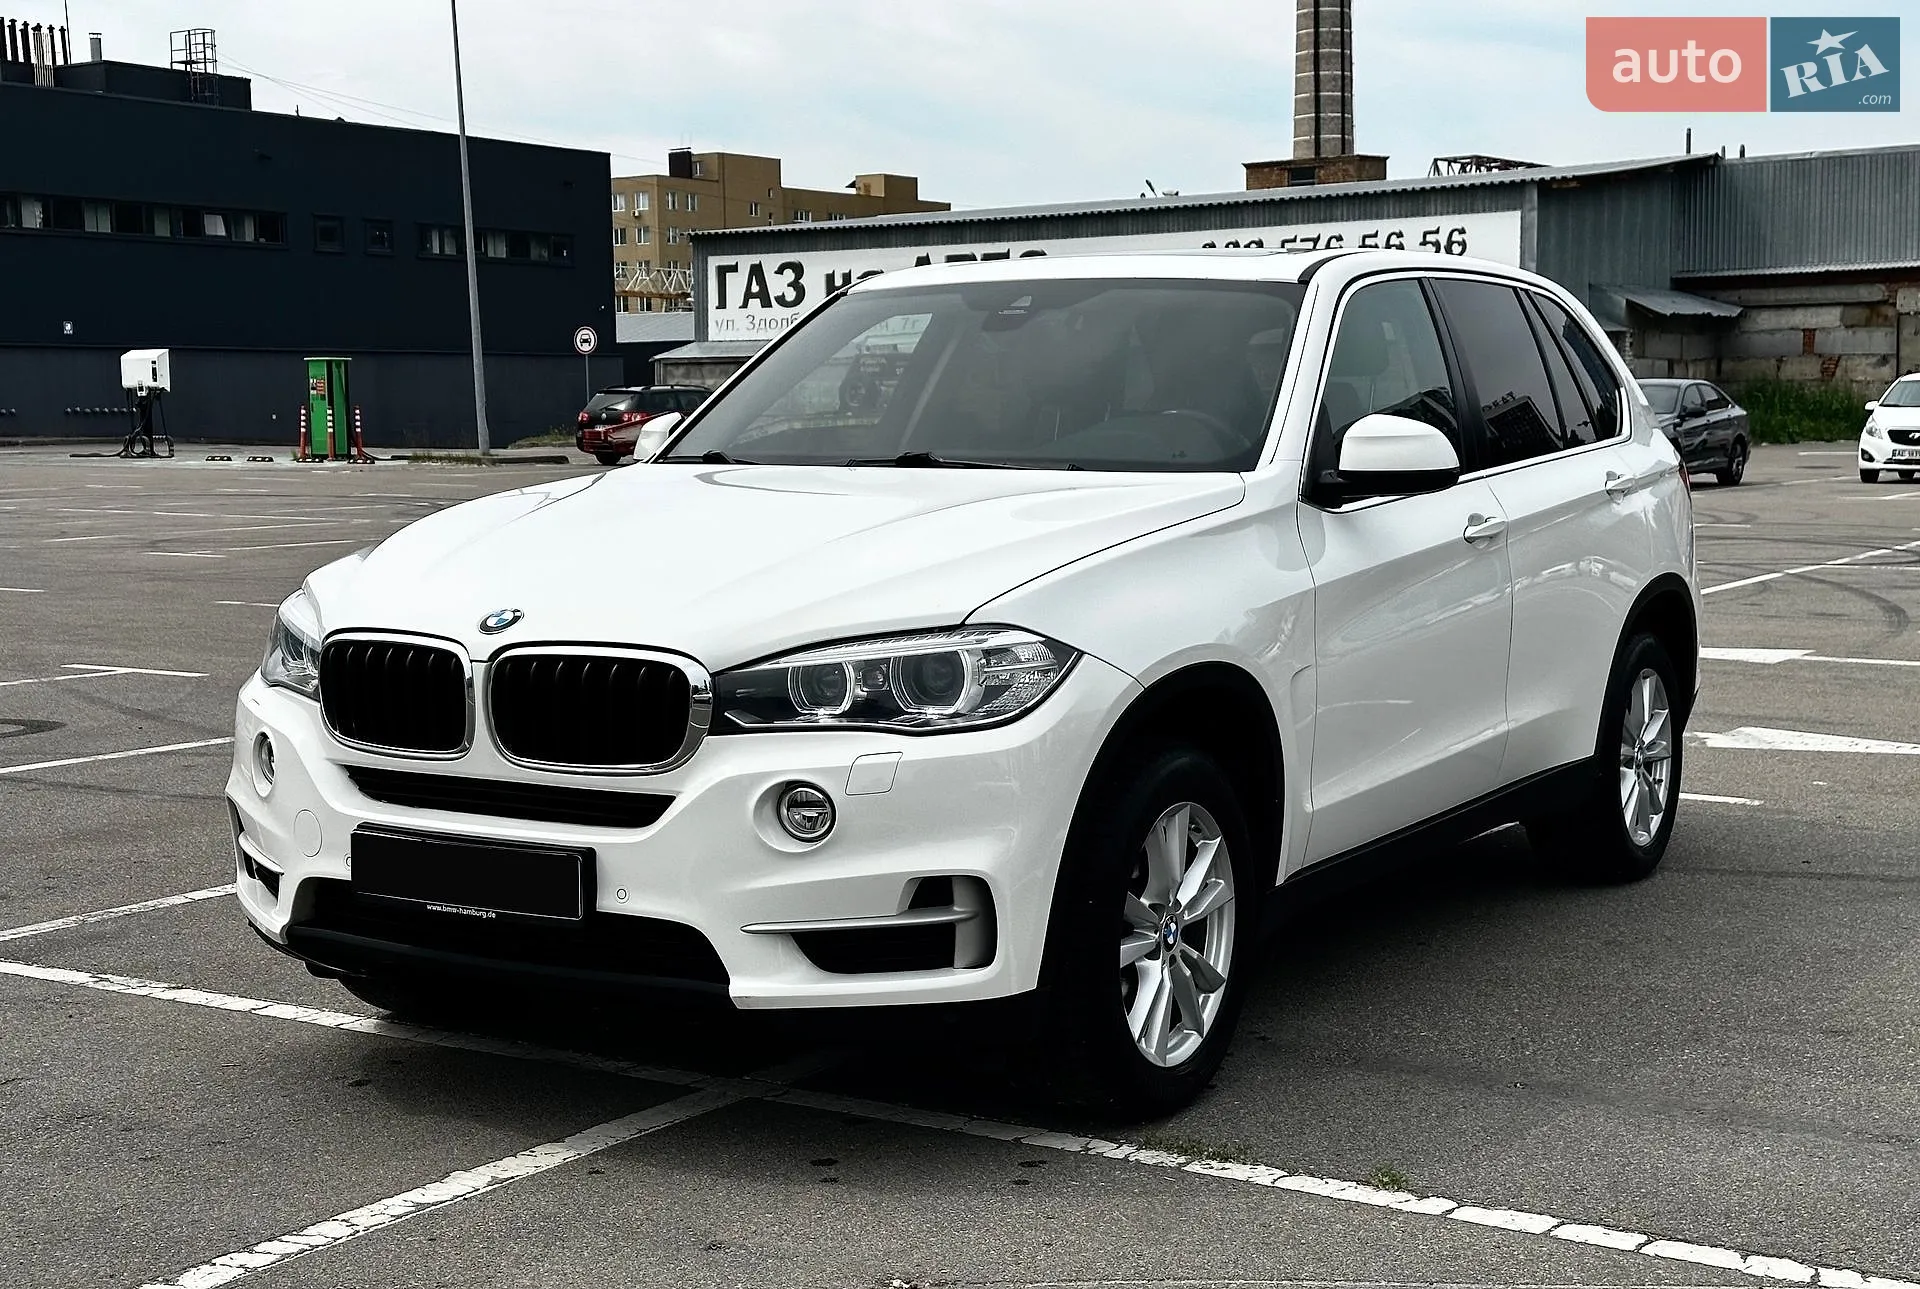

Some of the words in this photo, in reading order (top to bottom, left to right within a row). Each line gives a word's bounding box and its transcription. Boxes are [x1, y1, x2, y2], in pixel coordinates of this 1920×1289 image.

[1419, 226, 1467, 256] 56
[715, 260, 806, 309] ГАЗ
[825, 269, 884, 299] н
[715, 318, 739, 334] ул.
[427, 904, 496, 918] www.bmw-hamburg.de
